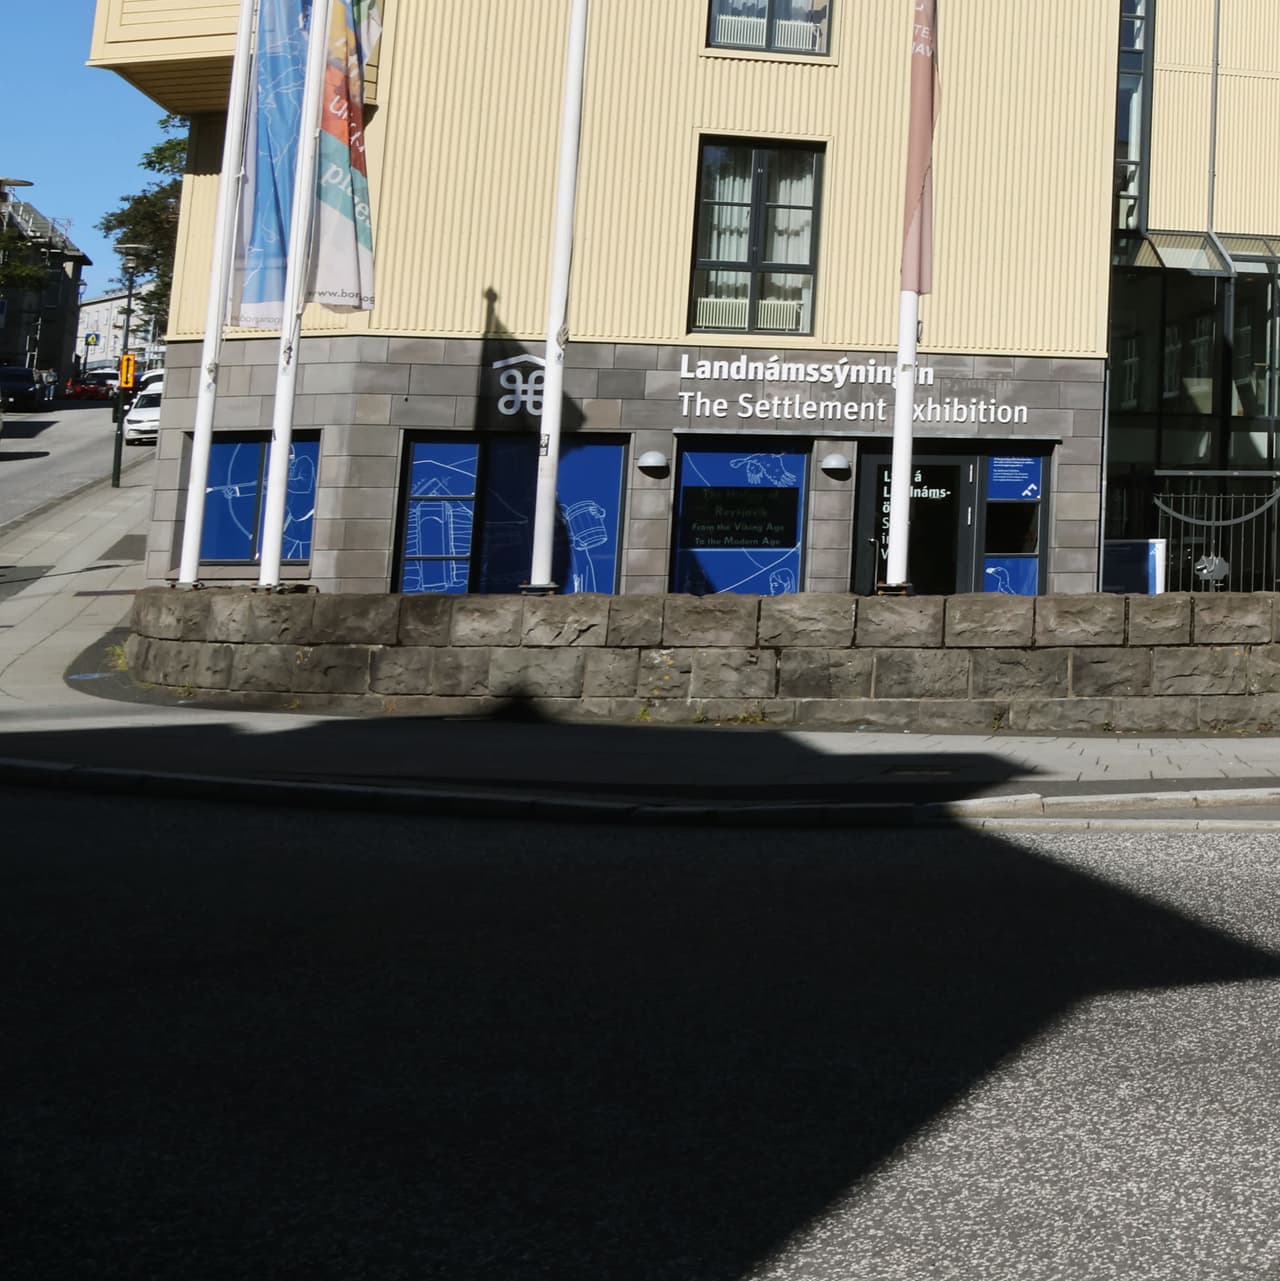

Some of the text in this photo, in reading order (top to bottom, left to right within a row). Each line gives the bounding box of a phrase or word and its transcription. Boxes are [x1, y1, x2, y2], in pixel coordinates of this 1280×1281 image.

[678, 391, 1028, 424] The Settlement xhibition
